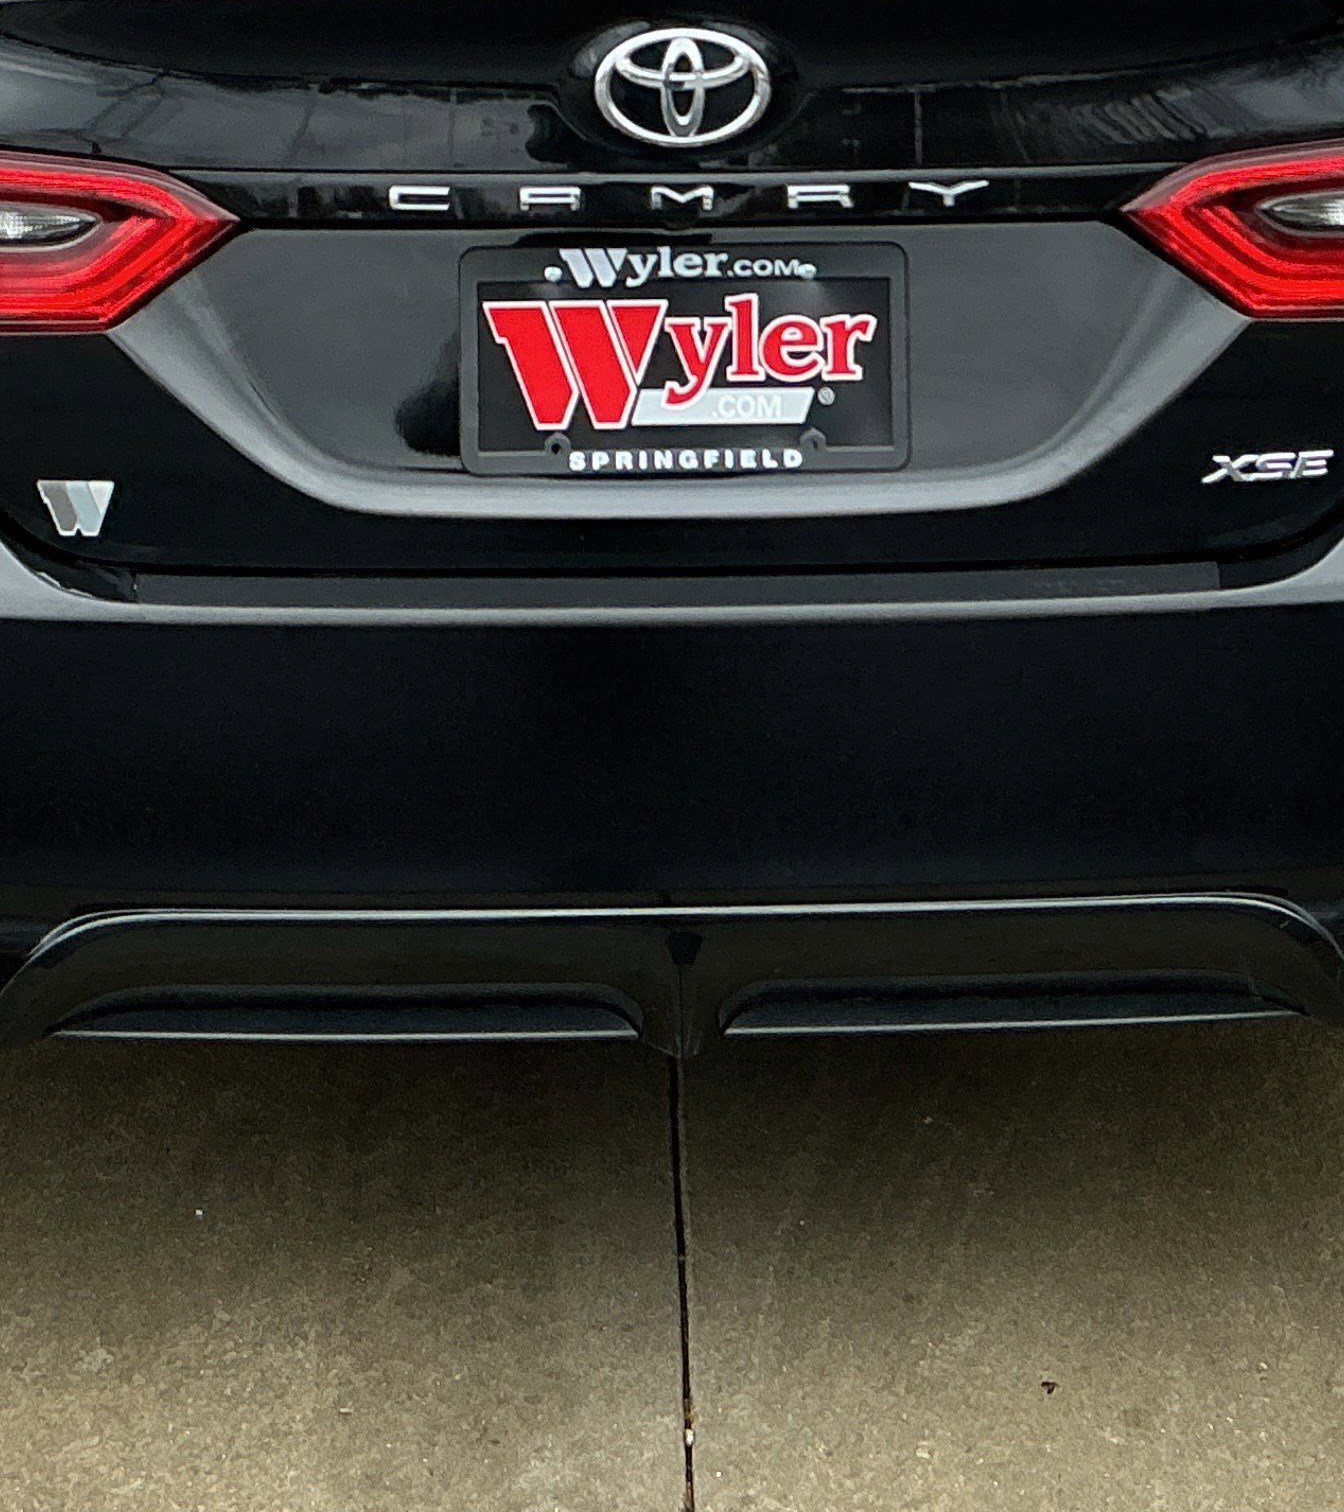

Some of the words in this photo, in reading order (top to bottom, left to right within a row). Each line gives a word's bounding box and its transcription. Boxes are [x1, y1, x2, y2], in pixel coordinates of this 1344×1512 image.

[388, 180, 990, 211] CAMRY
[482, 293, 877, 431] Wyler
[568, 448, 804, 473] SPRINGFIELD
[1201, 449, 1335, 484] XSE
